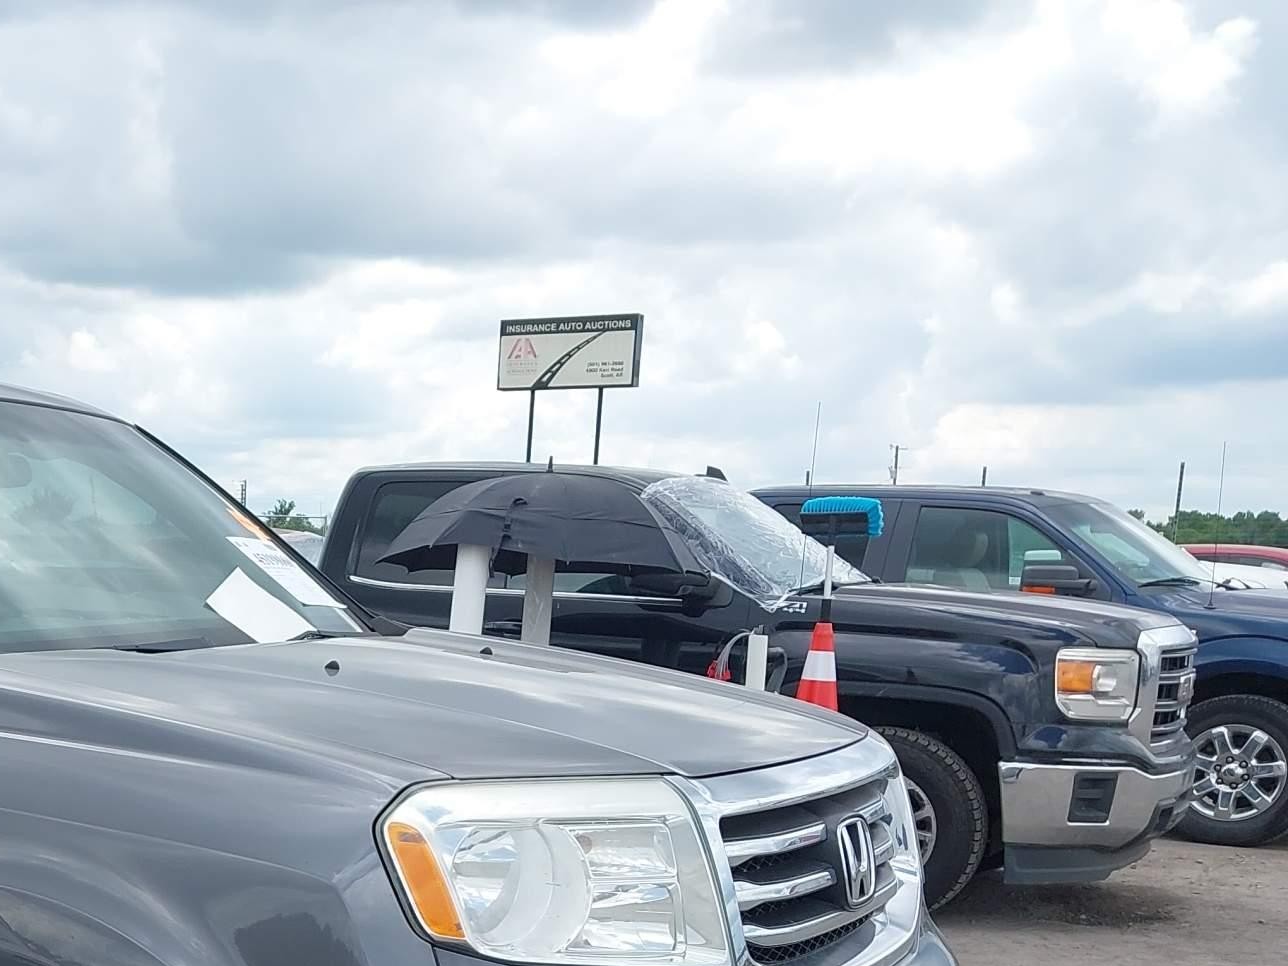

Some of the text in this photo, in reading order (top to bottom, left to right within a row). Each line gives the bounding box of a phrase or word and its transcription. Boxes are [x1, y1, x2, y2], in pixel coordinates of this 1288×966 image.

[506, 319, 632, 333] INSURANCE AUTO AUCTIONS
